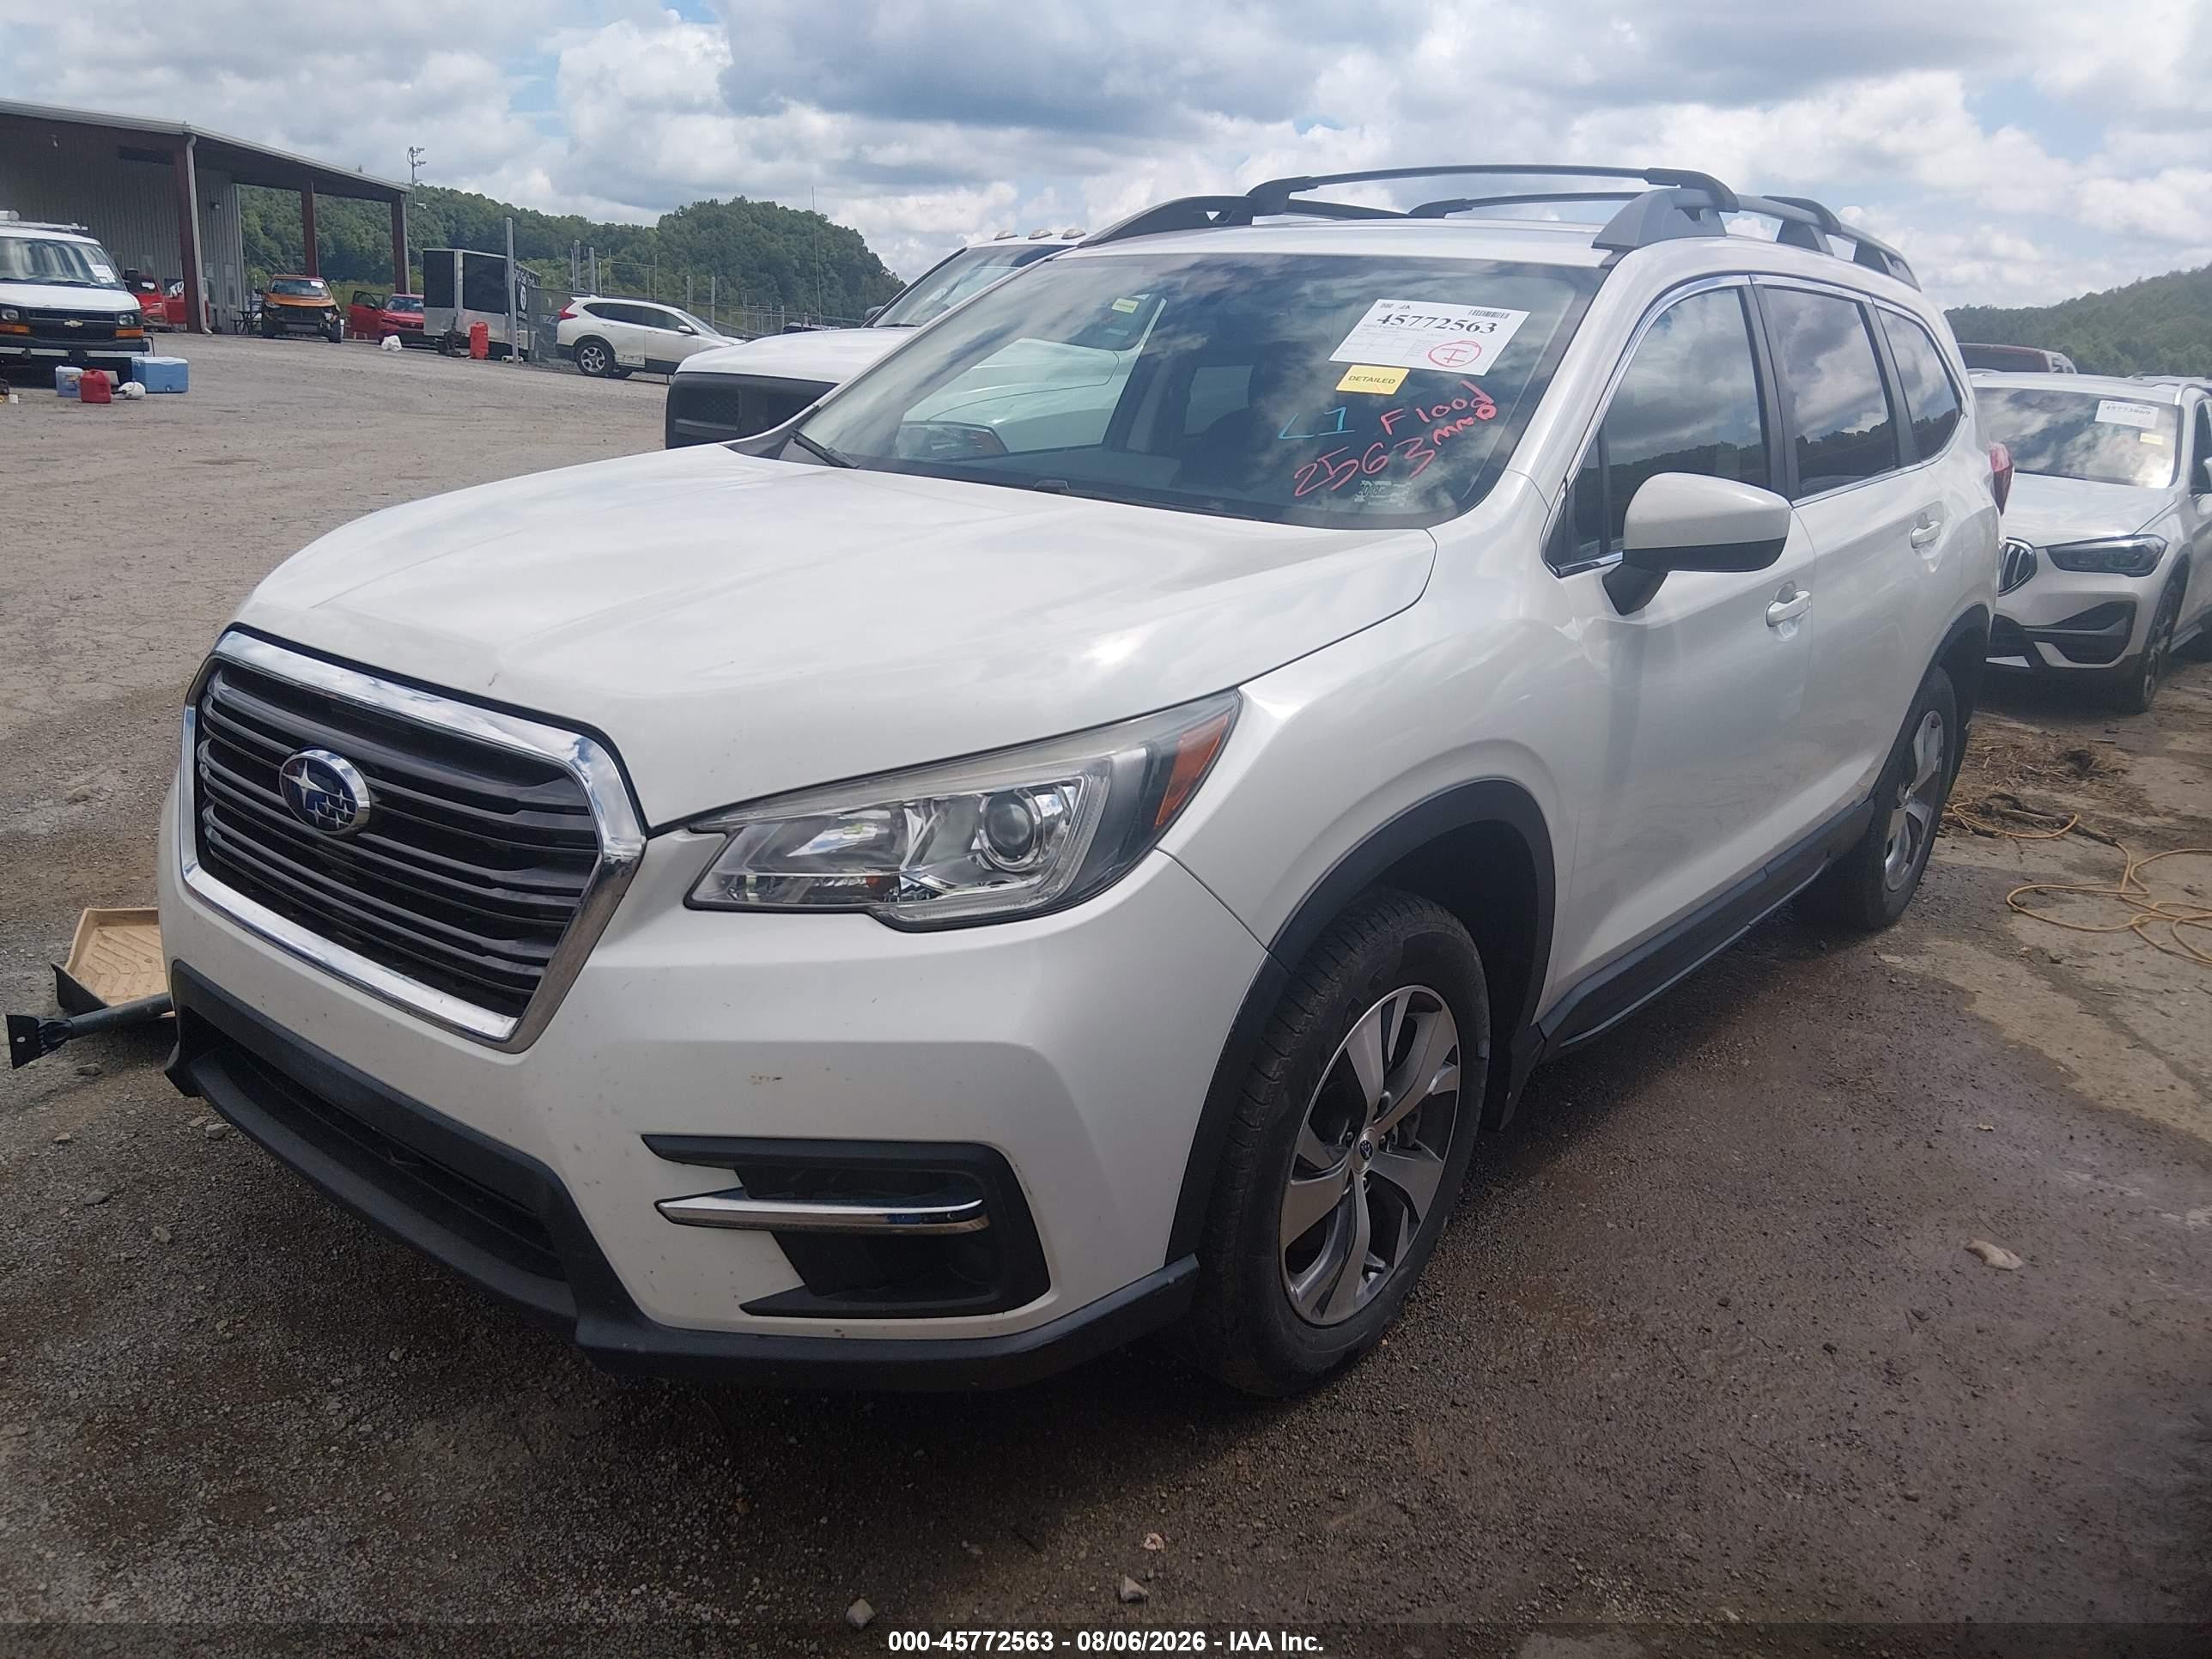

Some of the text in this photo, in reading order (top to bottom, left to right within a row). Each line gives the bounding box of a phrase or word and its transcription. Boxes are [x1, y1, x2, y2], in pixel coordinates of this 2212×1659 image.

[1376, 313, 1498, 334] 45772563
[1348, 374, 1396, 385] DETAILED
[1293, 437, 1436, 497] 2563
